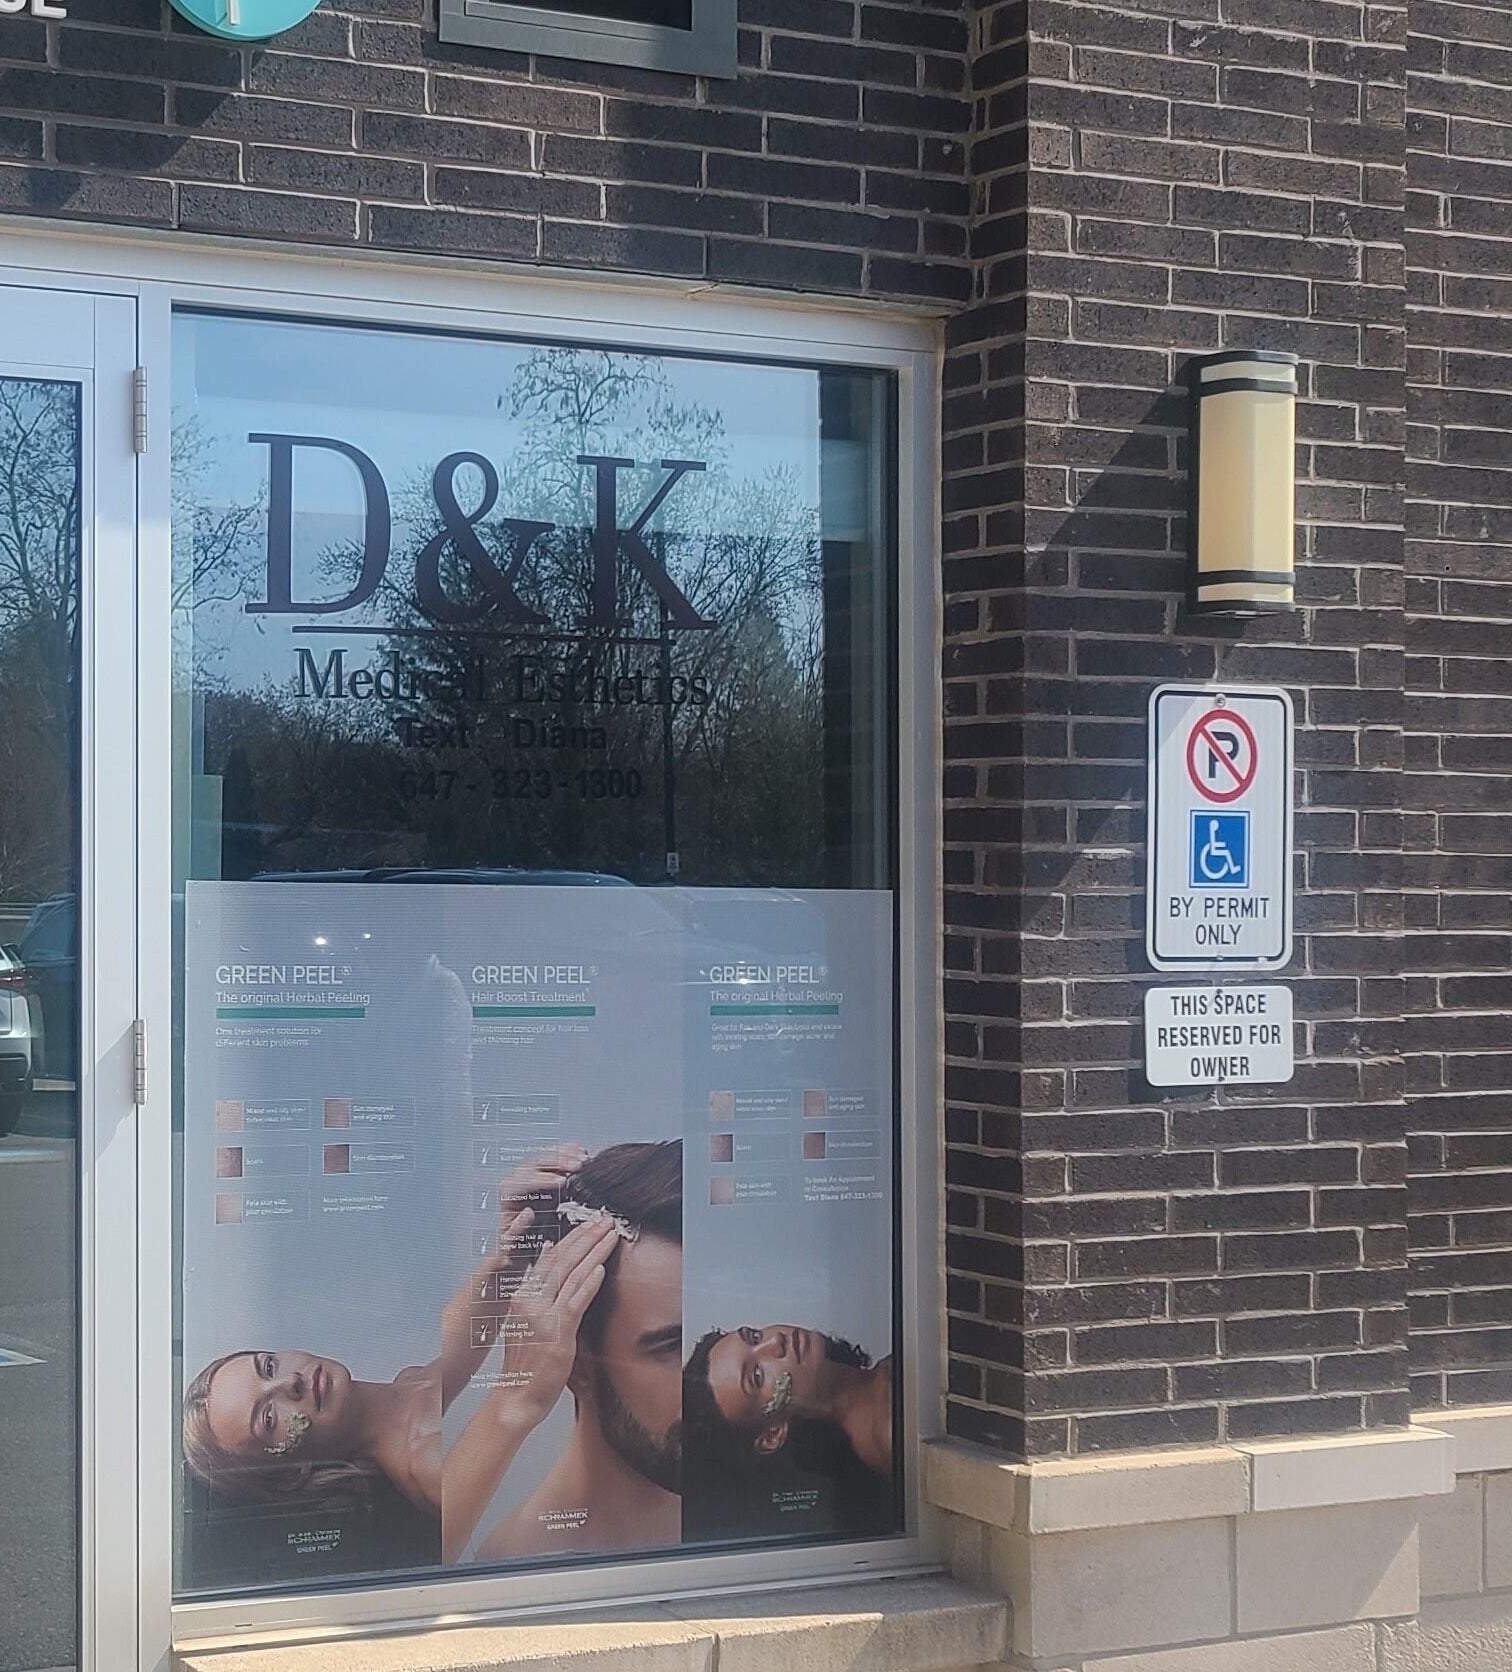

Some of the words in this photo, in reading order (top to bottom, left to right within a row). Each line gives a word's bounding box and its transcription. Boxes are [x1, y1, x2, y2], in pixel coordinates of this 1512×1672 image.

[245, 433, 717, 629] D&K
[295, 648, 484, 701] Medical
[512, 655, 710, 705] Esthetics
[394, 716, 470, 748] Text
[513, 717, 607, 750] Diana
[1170, 897, 1194, 918] BY
[1204, 897, 1270, 918] PERMIT
[1196, 924, 1242, 945] ONLY
[215, 965, 286, 984] GREEN
[472, 965, 537, 984] GREEN
[709, 965, 771, 984] GREEN
[215, 991, 238, 1003] The
[240, 991, 283, 1006] original
[286, 992, 326, 1003] Herbal
[327, 991, 370, 1006] Peeling
[472, 991, 493, 1003] Hair
[496, 991, 527, 1002] Boost
[529, 990, 586, 1002] Treatment
[710, 990, 728, 1002] The
[731, 990, 769, 1004] original
[771, 990, 805, 1002] Herbal
[806, 989, 844, 1003] Peeling
[1170, 994, 1208, 1016] THIS
[1213, 993, 1267, 1015] SPACE
[1158, 1026, 1242, 1048] RESERVED
[1249, 1024, 1281, 1045] FOR
[1191, 1056, 1250, 1078] OWNER
